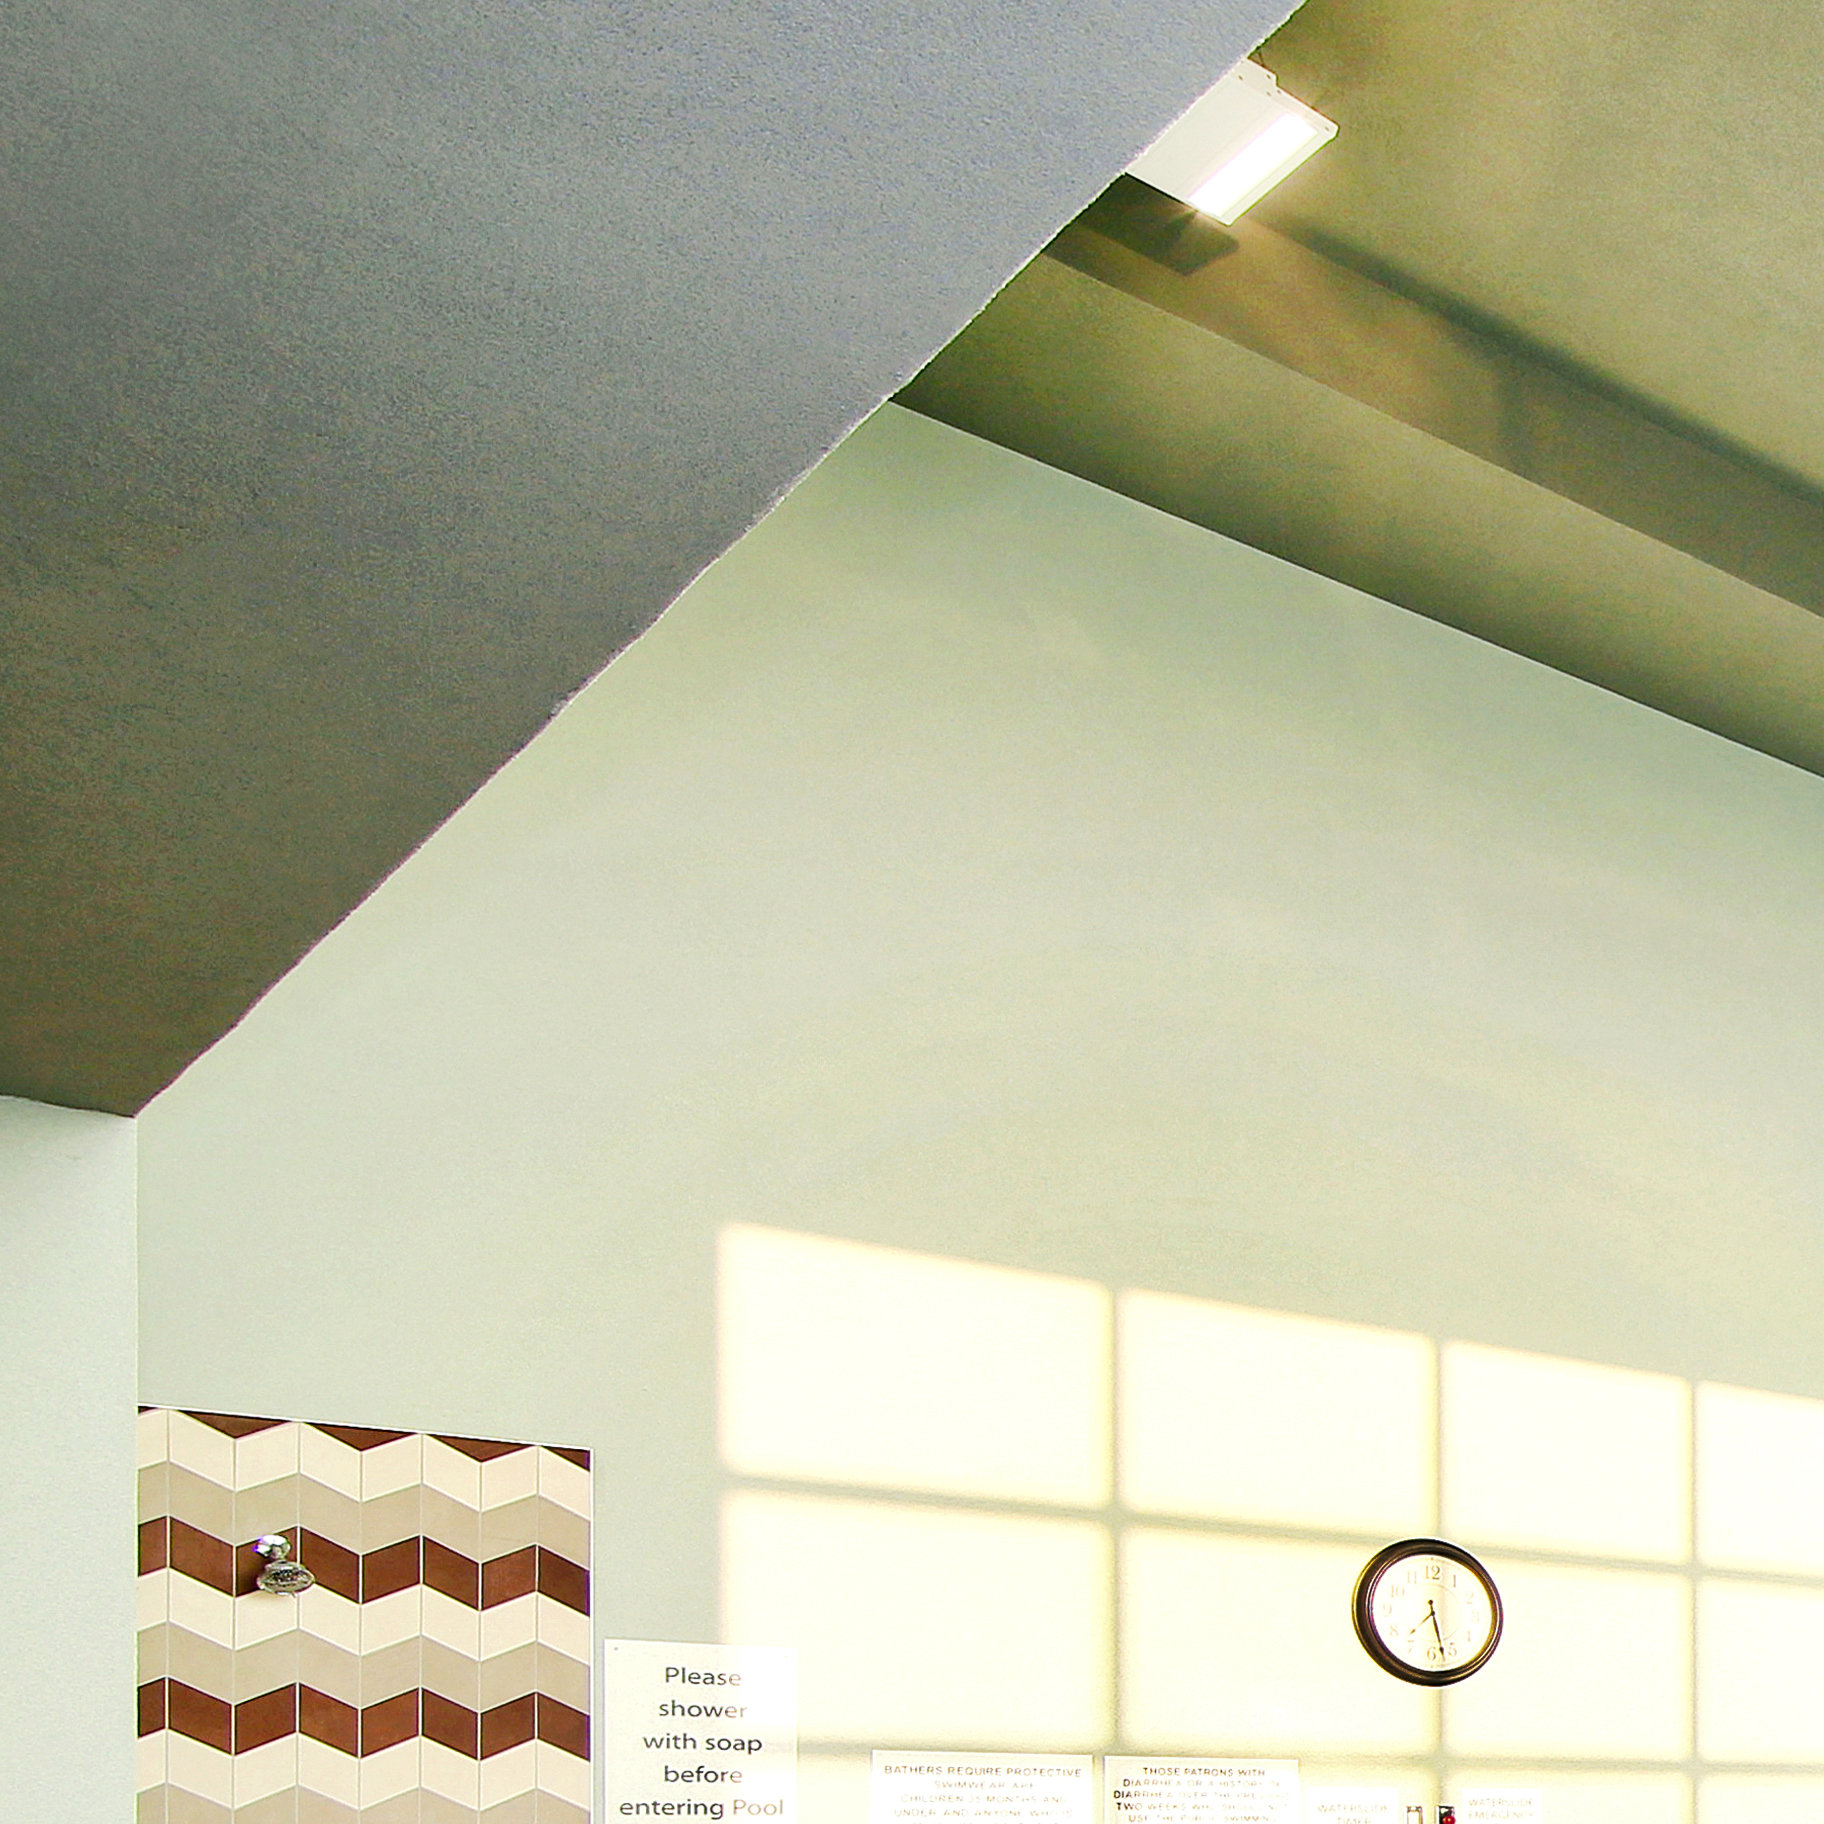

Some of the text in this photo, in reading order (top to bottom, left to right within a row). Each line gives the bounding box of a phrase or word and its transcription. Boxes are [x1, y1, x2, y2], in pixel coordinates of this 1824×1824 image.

[1425, 1565, 1441, 1580] 12
[1452, 1574, 1457, 1588] 1
[1390, 1584, 1405, 1599] 10
[1426, 1646, 1437, 1661] 6
[1447, 1642, 1457, 1657] 5
[664, 1666, 742, 1687] Please
[658, 1699, 748, 1719] shower
[642, 1732, 763, 1754] with soap
[664, 1765, 743, 1784] before
[884, 1765, 1082, 1778] BATHERS REQUIRE PROTECTIVE
[1142, 1767, 1266, 1777] THOSE PATRONS WITH
[935, 1780, 1006, 1790] SWIMWEAR
[1122, 1778, 1182, 1788] DIARRHEA
[900, 1794, 965, 1803] CHILDREN
[1113, 1789, 1173, 1799] DIARRHEA
[619, 1799, 784, 1820] entering Pool
[894, 1808, 937, 1817] UNDER
[943, 1808, 968, 1817] AND
[1115, 1801, 1144, 1811] TWO
